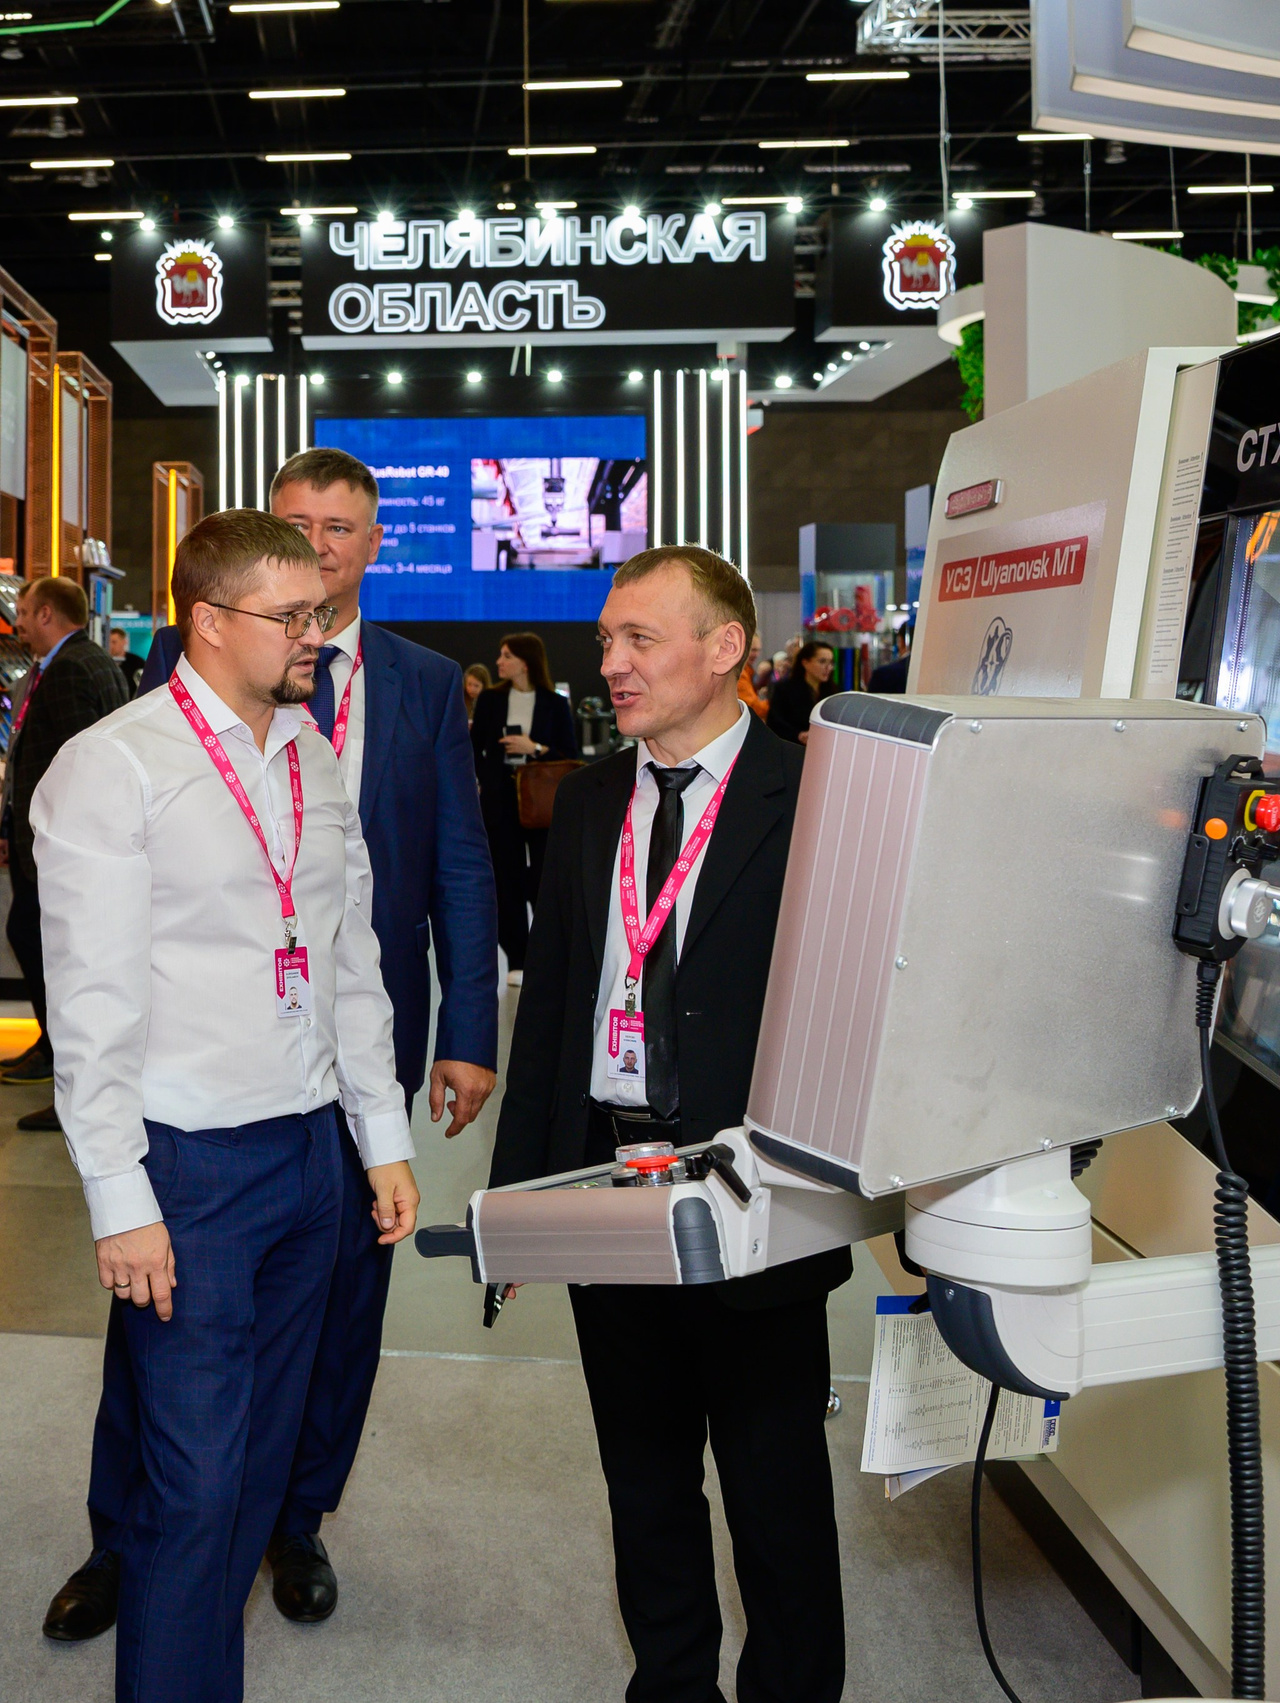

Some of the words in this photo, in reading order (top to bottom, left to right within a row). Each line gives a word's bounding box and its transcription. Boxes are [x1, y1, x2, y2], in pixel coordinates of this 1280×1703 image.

[328, 211, 766, 271] ЧЕЛЯБИНСКАЯ
[328, 280, 606, 333] ОБЛАСТЬ
[981, 551, 1050, 593] Ulyanovsk
[1052, 544, 1081, 577] MT
